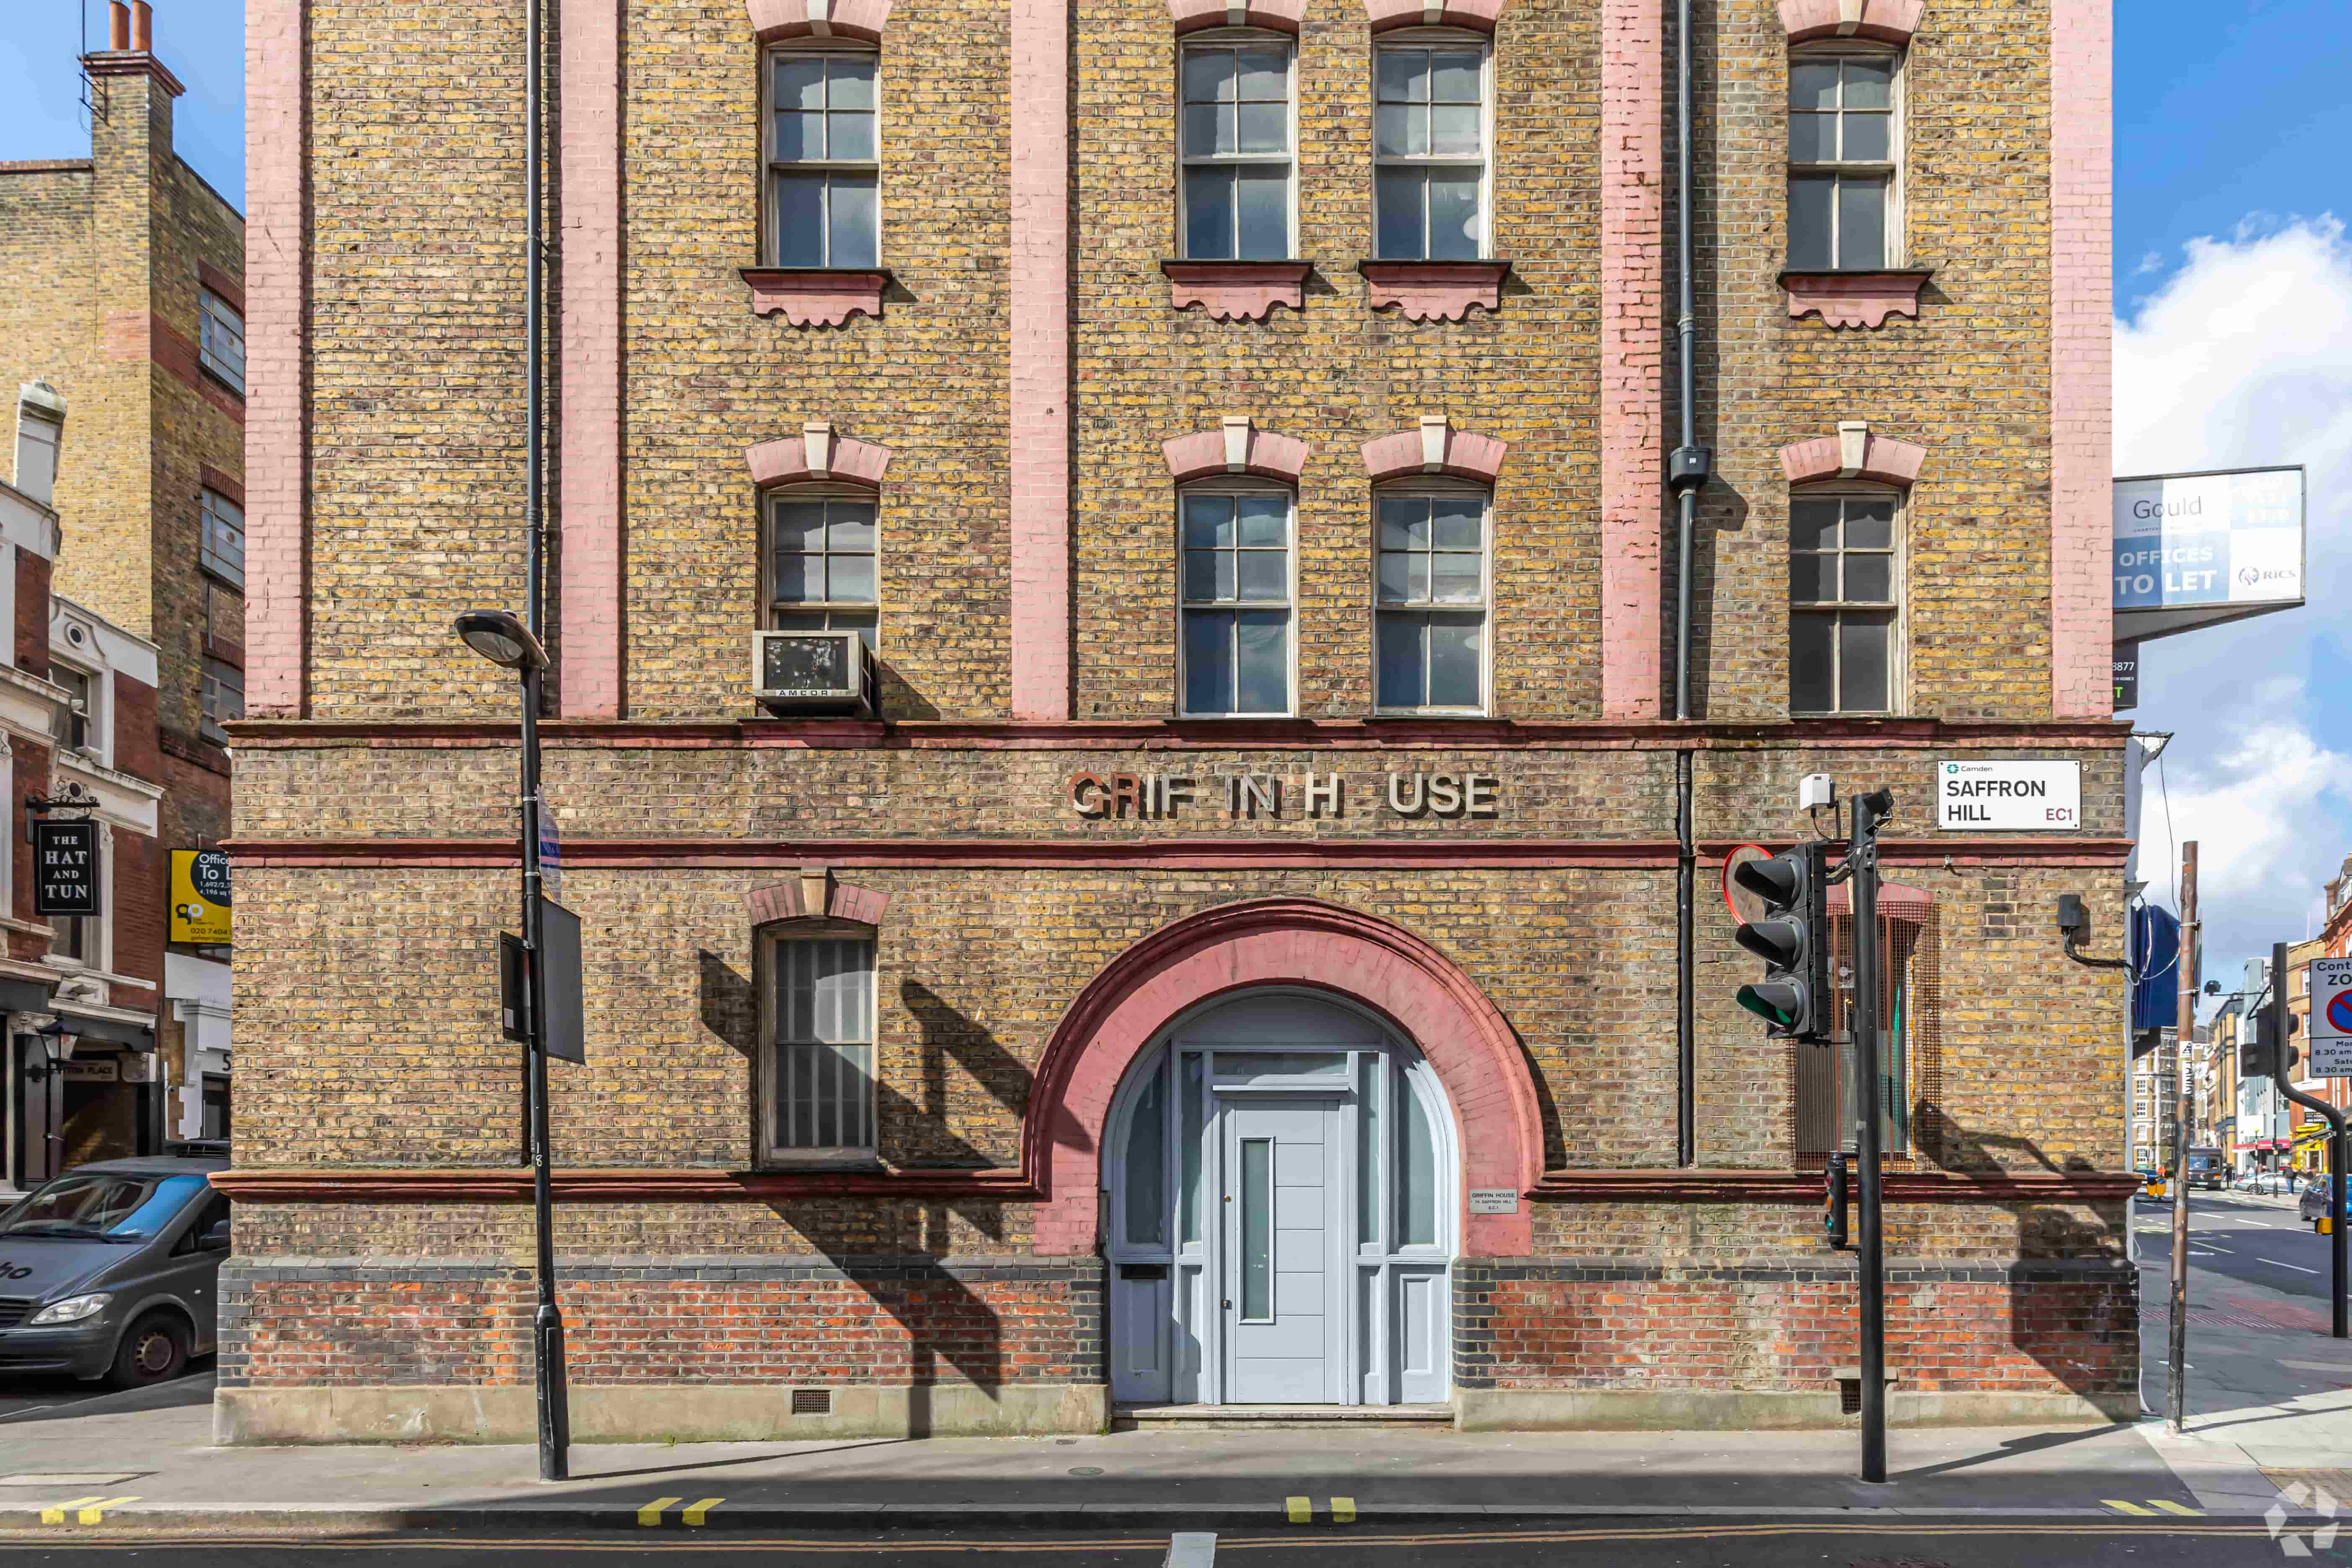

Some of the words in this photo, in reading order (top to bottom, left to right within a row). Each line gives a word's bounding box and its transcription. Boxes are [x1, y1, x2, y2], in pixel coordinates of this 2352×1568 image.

[2133, 496, 2202, 519] Gould
[2119, 545, 2214, 567] OFFICES
[2114, 574, 2154, 595] TO
[2165, 569, 2218, 593] LET
[2263, 570, 2296, 579] RICS
[1947, 780, 2046, 797] SAFFRON
[1948, 805, 1991, 821] HILL
[2046, 808, 2073, 821] EC1
[52, 836, 77, 845] THE
[45, 851, 88, 865] HAT
[53, 870, 79, 878] AND
[199, 865, 219, 880] To
[45, 884, 88, 899] TUN
